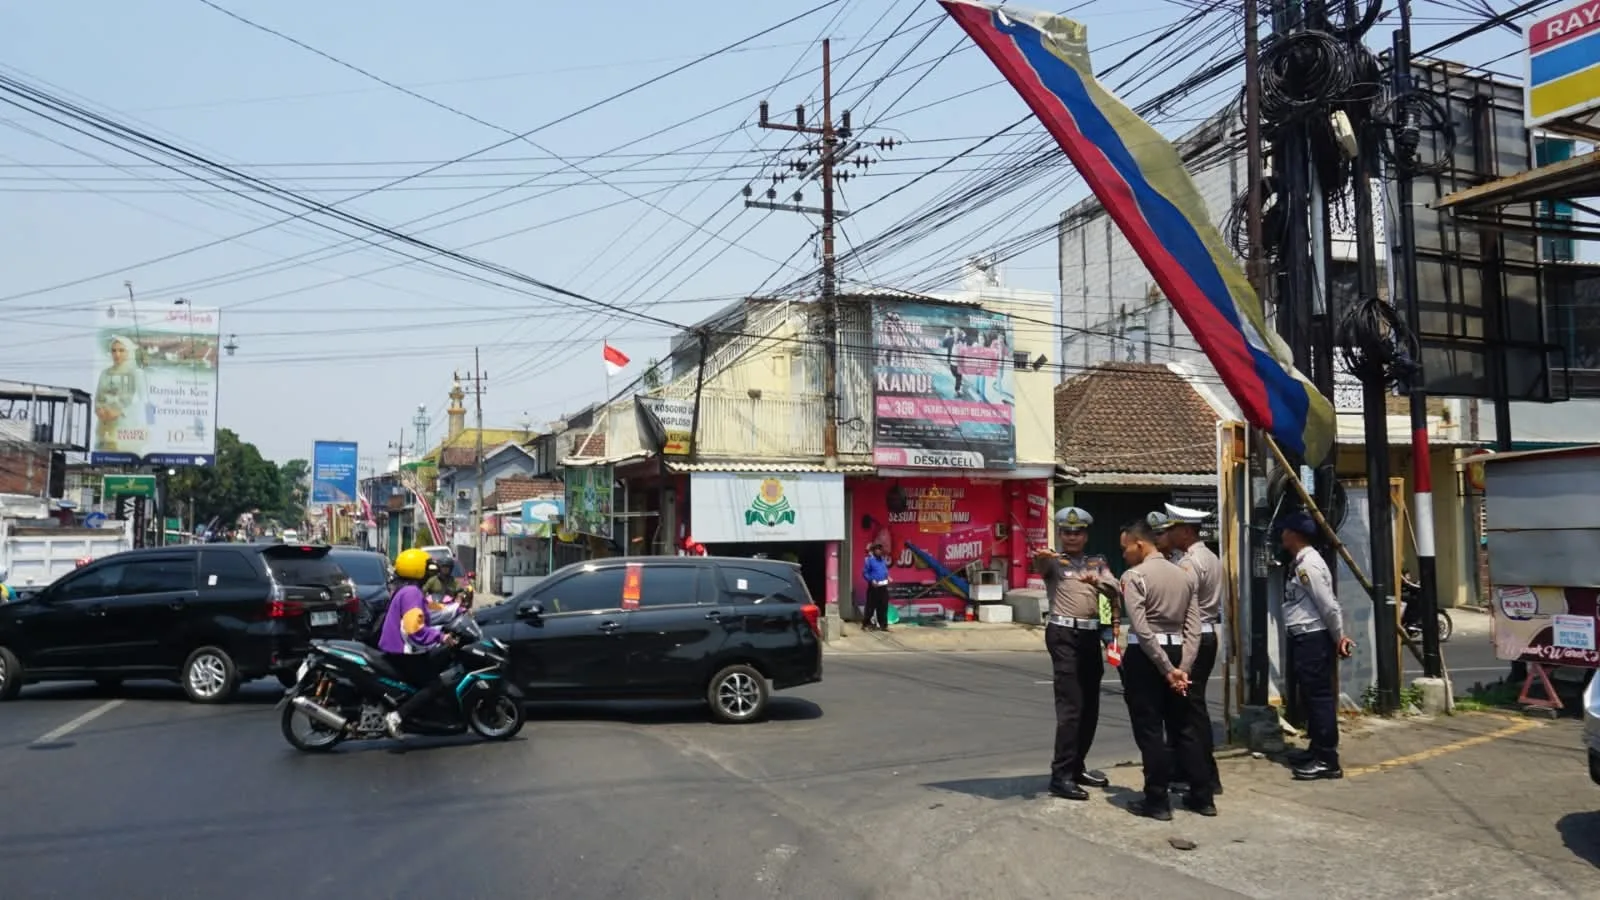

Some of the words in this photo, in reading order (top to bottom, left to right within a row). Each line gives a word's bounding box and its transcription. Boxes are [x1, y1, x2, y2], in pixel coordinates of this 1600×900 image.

[1547, 3, 1600, 40] RAY
[877, 373, 932, 393] KAMU!
[914, 455, 948, 466] DESKA
[951, 456, 975, 467] CELL
